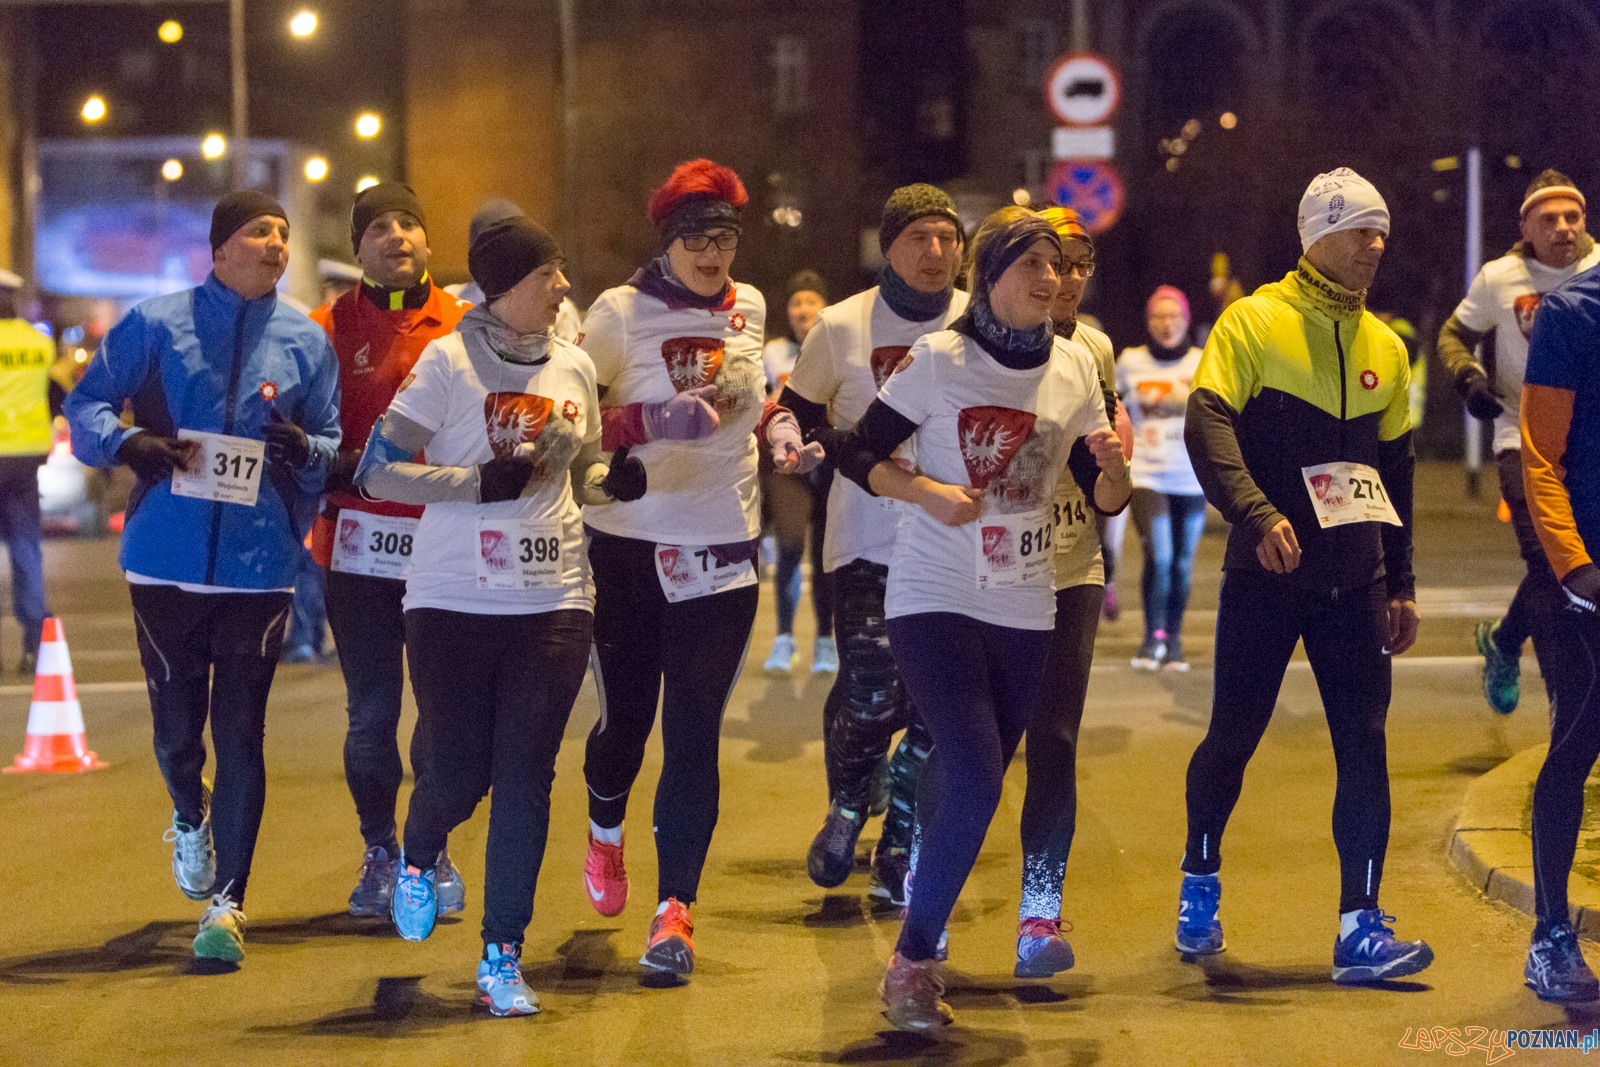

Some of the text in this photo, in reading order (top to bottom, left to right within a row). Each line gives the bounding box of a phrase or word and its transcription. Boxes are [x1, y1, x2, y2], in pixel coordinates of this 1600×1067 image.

[213, 452, 258, 480] 317
[1348, 478, 1387, 503] 271
[369, 530, 414, 557] 308
[518, 536, 560, 563] 398
[1020, 523, 1052, 557] 812
